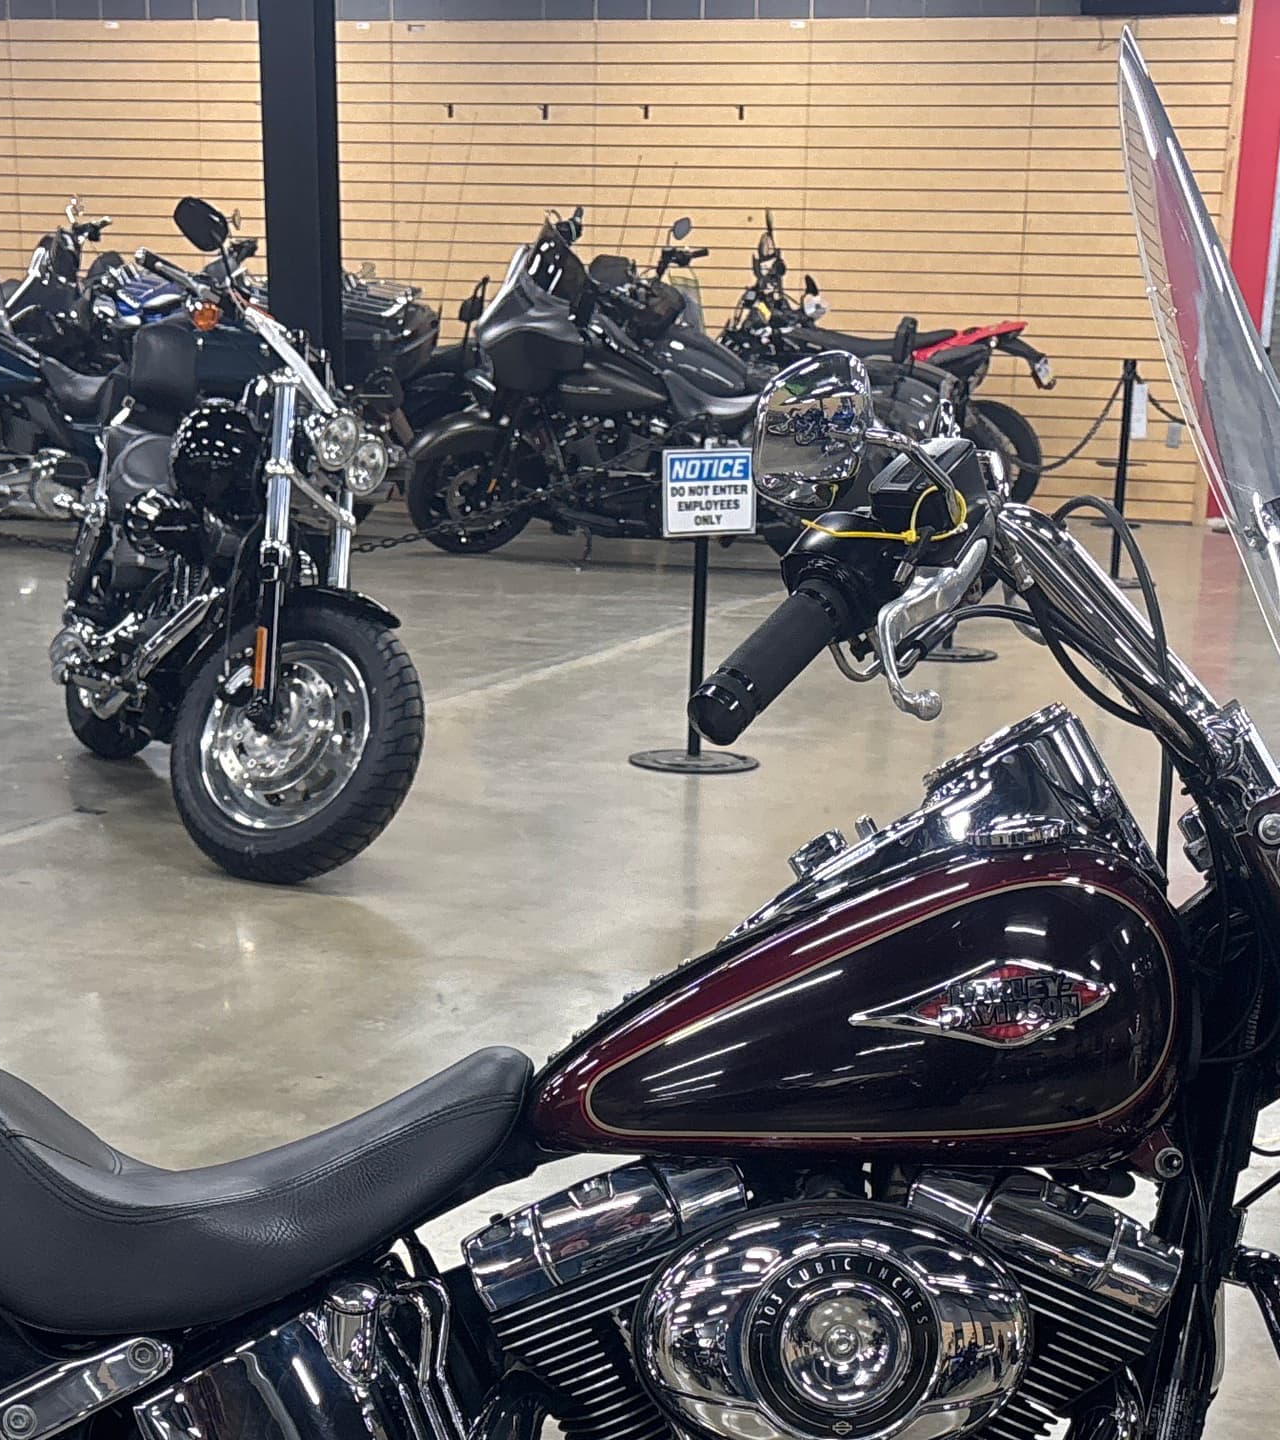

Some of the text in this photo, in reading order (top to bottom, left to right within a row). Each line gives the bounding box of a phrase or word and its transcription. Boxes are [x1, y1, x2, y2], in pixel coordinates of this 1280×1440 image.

[672, 458, 747, 480] NOTICE
[670, 484, 748, 498] DO NOT ENTER
[677, 499, 741, 512] EMPLOYEES
[694, 514, 723, 526] ONLY
[938, 993, 1082, 1030] DAVIDSON
[754, 1257, 929, 1327] 103 CUBIC INCHES
